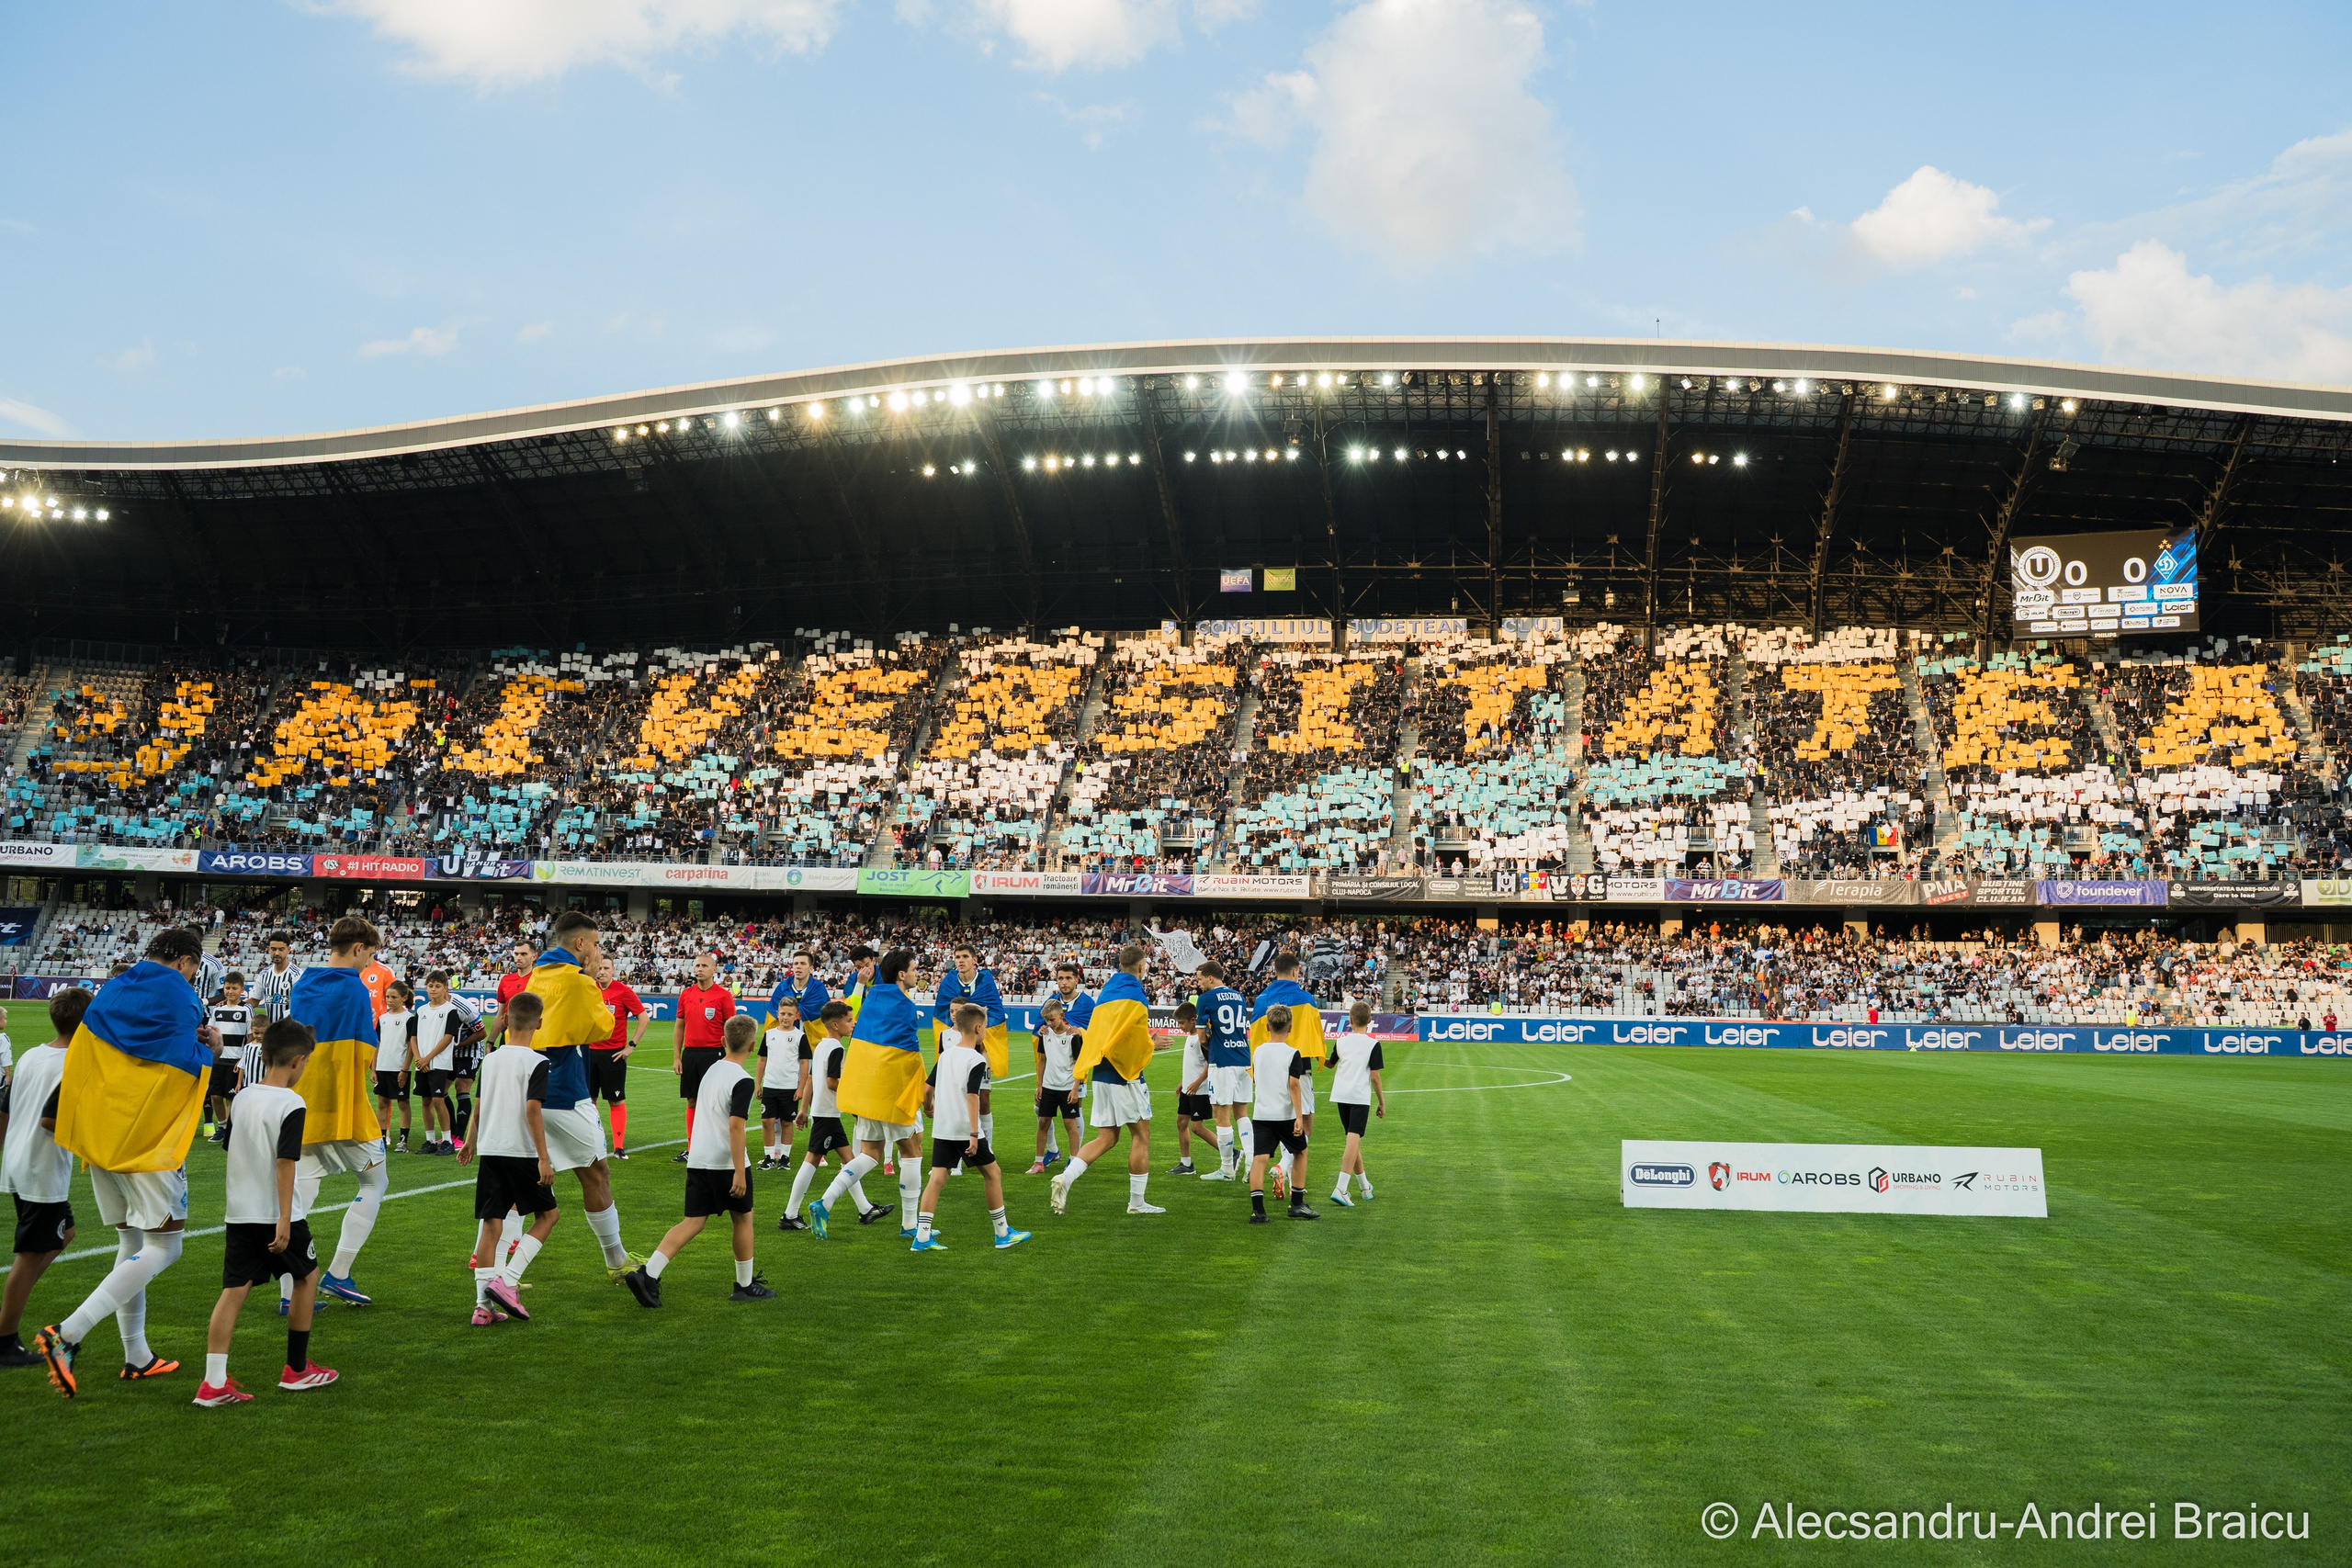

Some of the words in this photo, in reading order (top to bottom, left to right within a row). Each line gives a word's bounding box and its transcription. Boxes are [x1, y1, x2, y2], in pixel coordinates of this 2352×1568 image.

[2030, 558, 2050, 578] U
[2065, 560, 2087, 586] 0
[2123, 557, 2146, 583] 0
[2020, 593, 2050, 603] MrBit
[2159, 586, 2188, 594] NOVA
[1196, 620, 1329, 636] CONSILIUL
[1503, 617, 1562, 635] CLUJ
[210, 854, 303, 871] AROBS
[347, 861, 359, 871] #1
[362, 862, 380, 872] HIT
[381, 863, 419, 873] RADIO
[665, 866, 729, 882] carpatina
[866, 871, 910, 882] JOST
[992, 876, 1039, 888] IRUM
[1105, 874, 1170, 893] MrBit
[1252, 877, 1303, 886] MOTORS
[1332, 880, 1361, 888] PRIMĂRIA
[1550, 875, 1569, 895] V
[1587, 874, 1606, 895] G
[1690, 879, 1759, 899] MrBit
[1828, 879, 1883, 897] Terapia
[1922, 879, 1967, 898] PMA
[1976, 887, 2025, 896] SPORTUL
[2076, 885, 2143, 897] foundever
[1976, 895, 2026, 903] CLUJEAN
[1217, 1004, 1247, 1034] 94
[1431, 1020, 1505, 1041] Leier
[1521, 1021, 1596, 1043] Leier
[1612, 1023, 1688, 1044] Leier
[1704, 1025, 1781, 1046] Leier
[1812, 1026, 1888, 1048] Leier
[1905, 1028, 1982, 1050] Leier
[1999, 1029, 2076, 1051] Leier
[2093, 1031, 2171, 1053] Leier
[2204, 1032, 2282, 1054] Leier
[1736, 1171, 1771, 1181] IRUM
[1792, 1172, 1860, 1185] AROBS
[1892, 1172, 1941, 1183] URBANO
[1984, 1174, 2037, 1182] RUBIN
